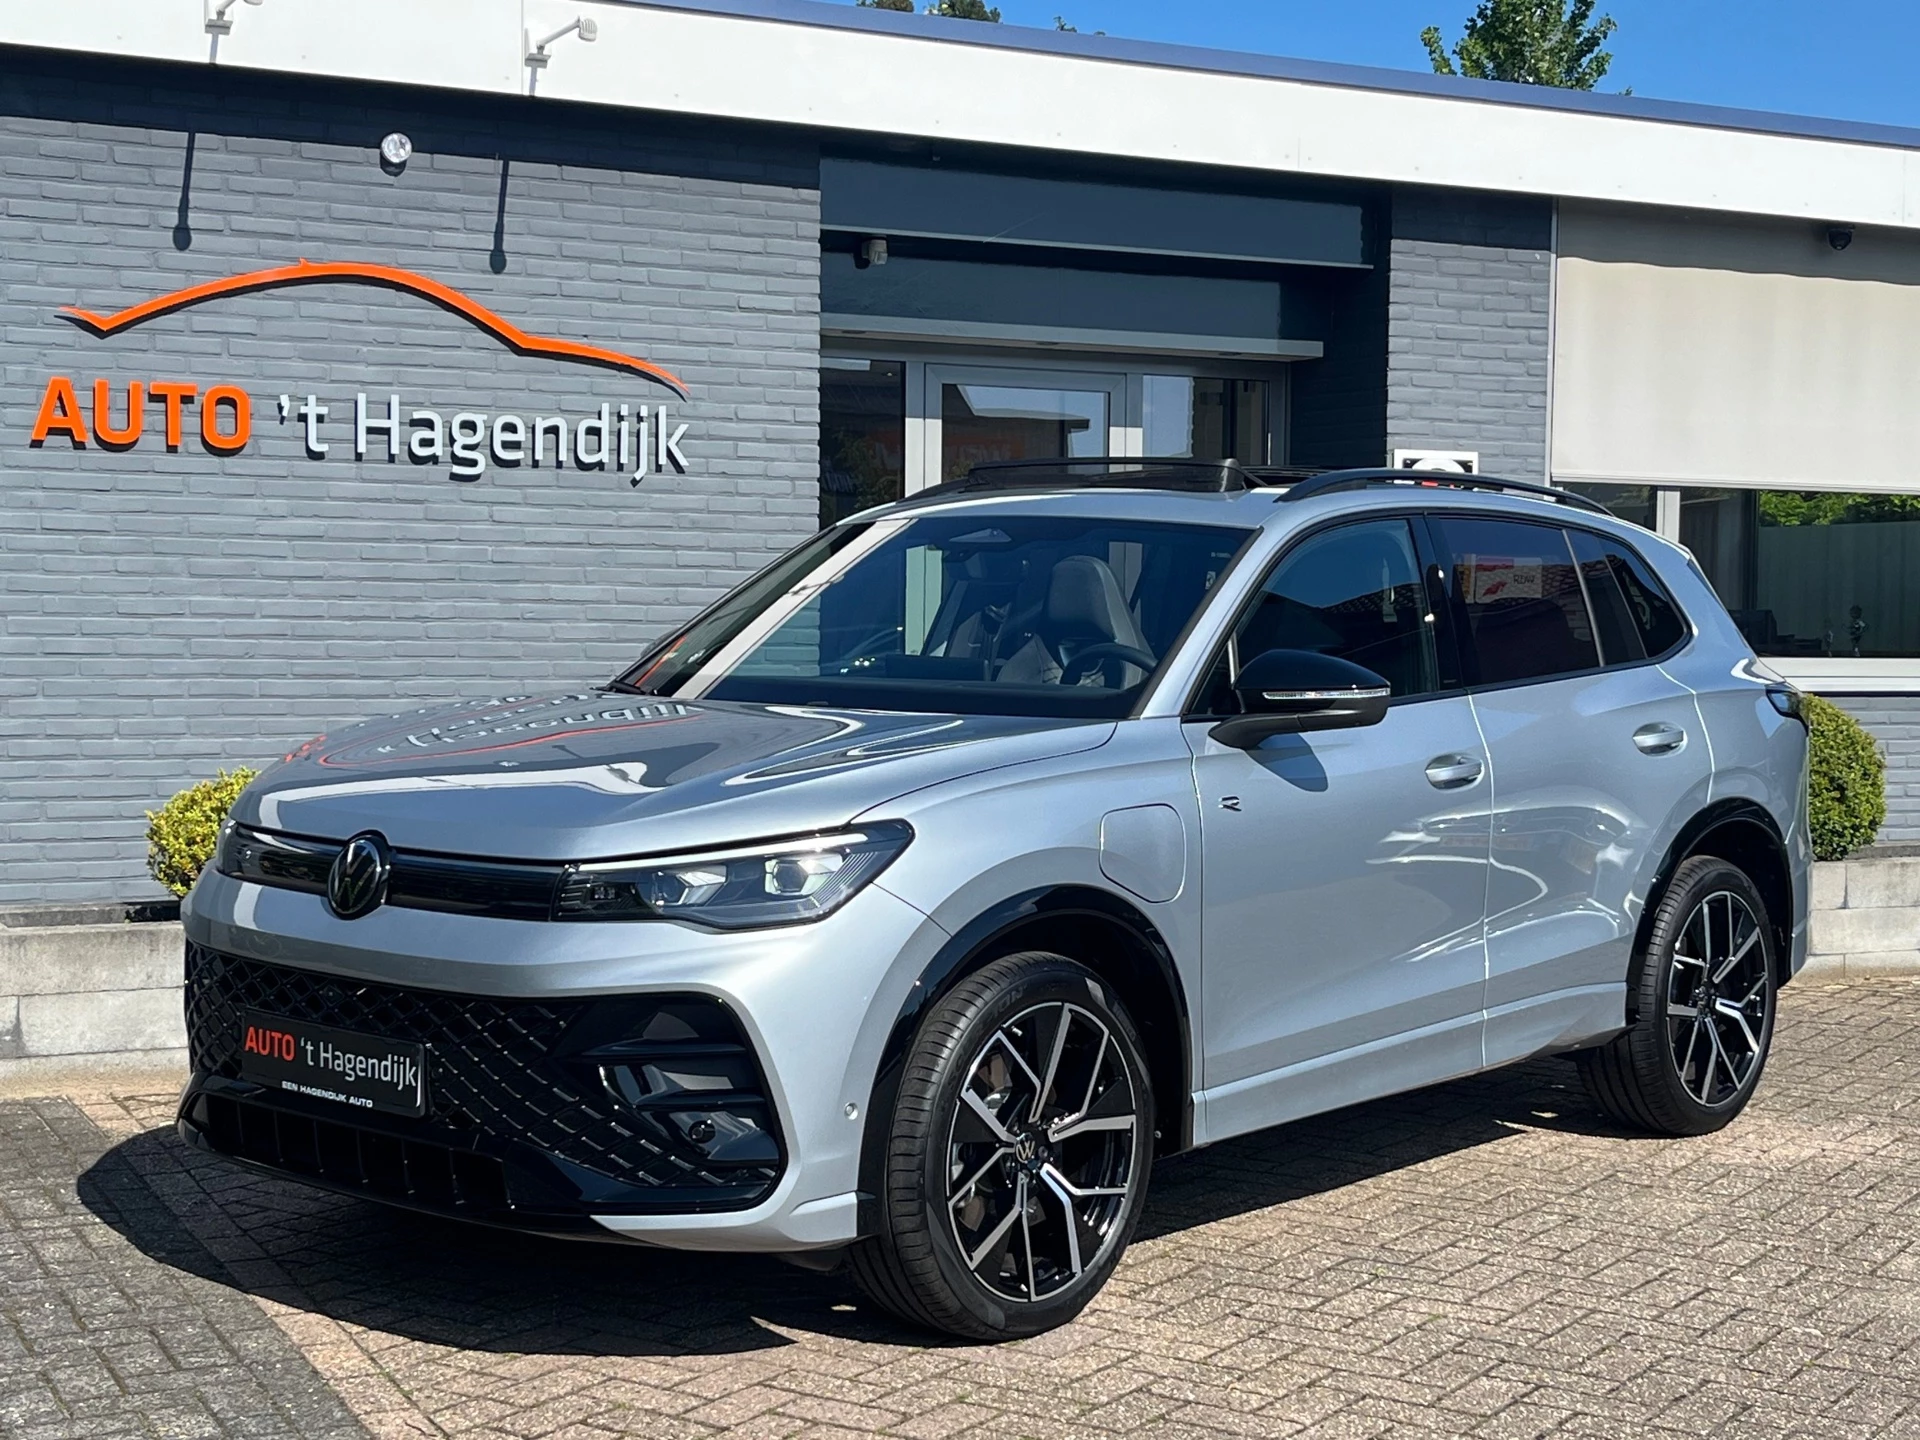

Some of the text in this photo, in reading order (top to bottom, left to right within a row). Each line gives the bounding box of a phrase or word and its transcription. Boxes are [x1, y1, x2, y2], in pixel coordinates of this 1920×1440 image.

[32, 376, 251, 449] AUTO
[357, 392, 690, 481] Hagendijk
[245, 1026, 296, 1061] AUTO
[319, 1041, 417, 1090] Hagendijk
[281, 1080, 374, 1108] EEN HAGENDIJK AUTO
